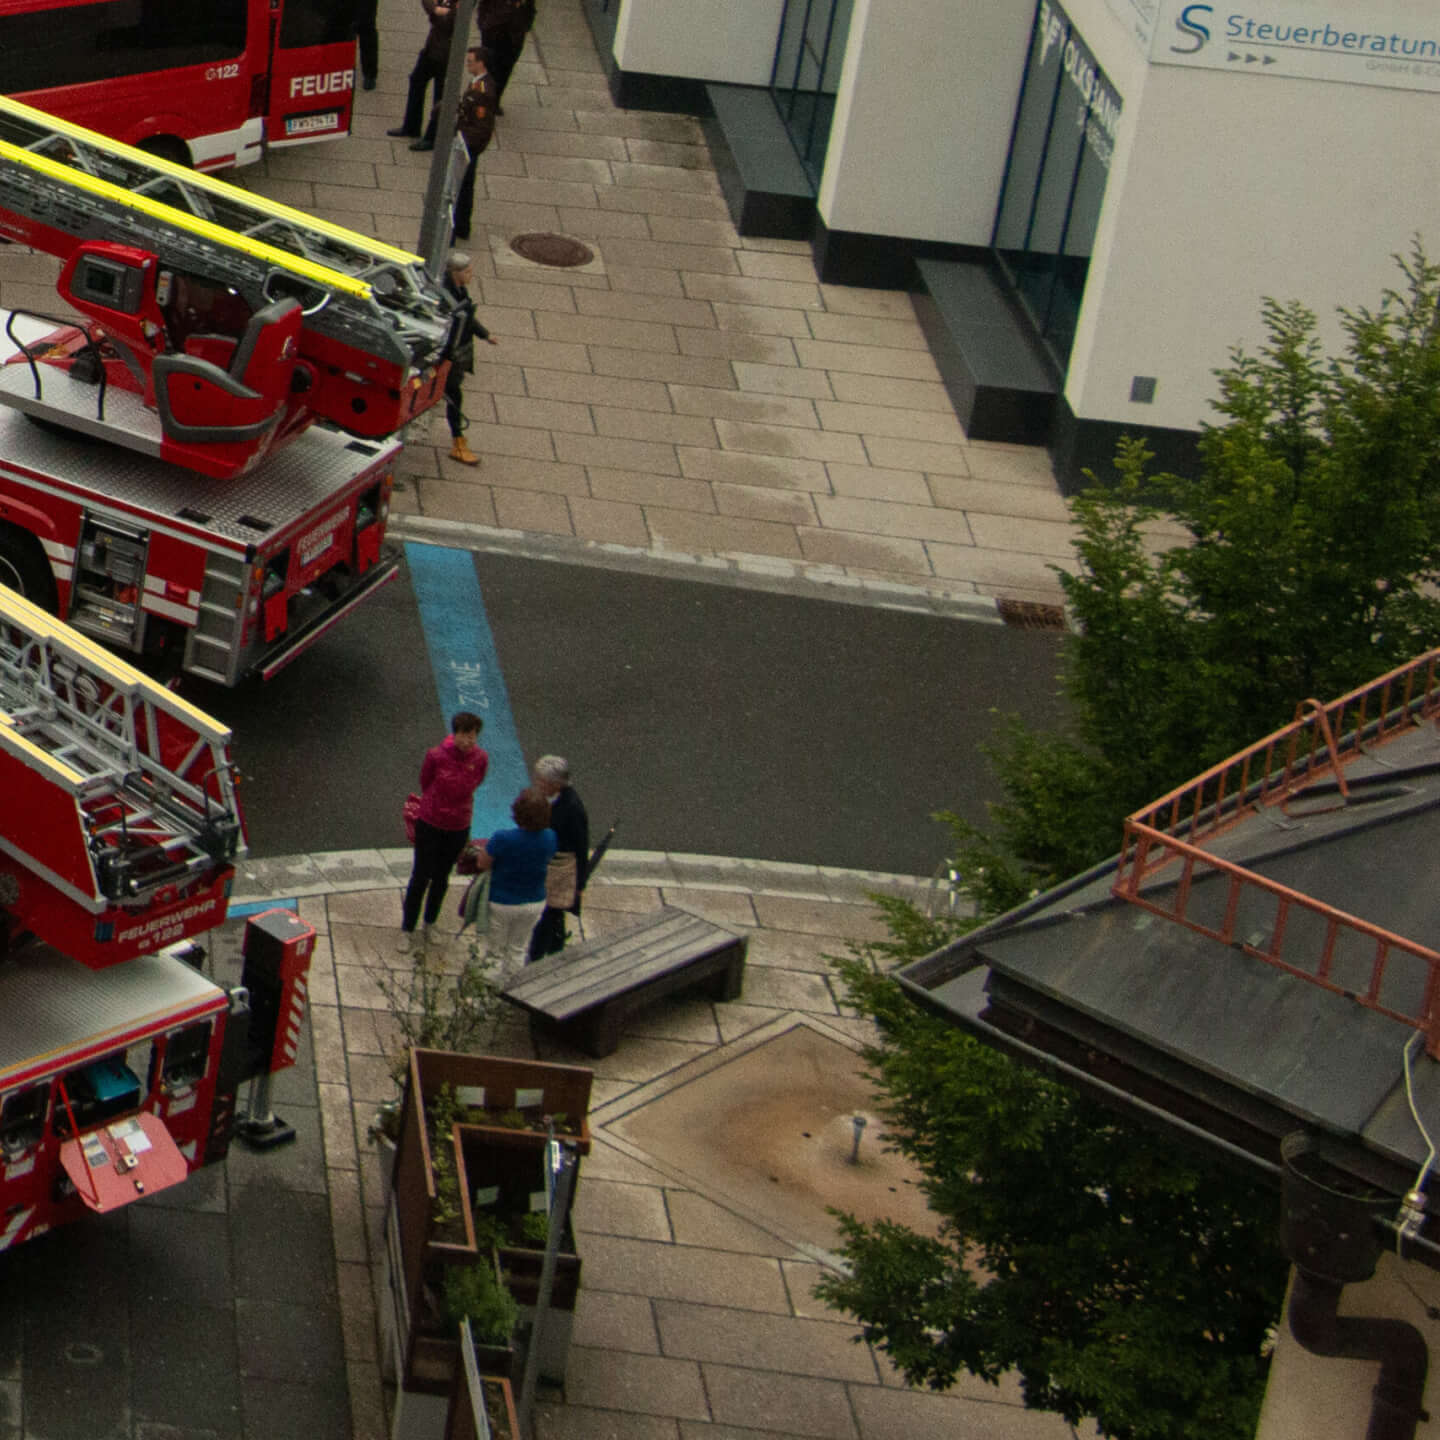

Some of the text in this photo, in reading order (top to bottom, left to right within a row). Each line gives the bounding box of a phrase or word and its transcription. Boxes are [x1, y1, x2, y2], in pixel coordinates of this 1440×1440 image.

[1225, 14, 1440, 58] Steuerberatun
[215, 63, 239, 80] 122
[289, 69, 354, 99] FEUER
[296, 505, 350, 554] FEUERWEHR
[451, 659, 489, 710] ZONE
[118, 900, 217, 943] FEUERWEHR
[154, 924, 184, 944] 122
